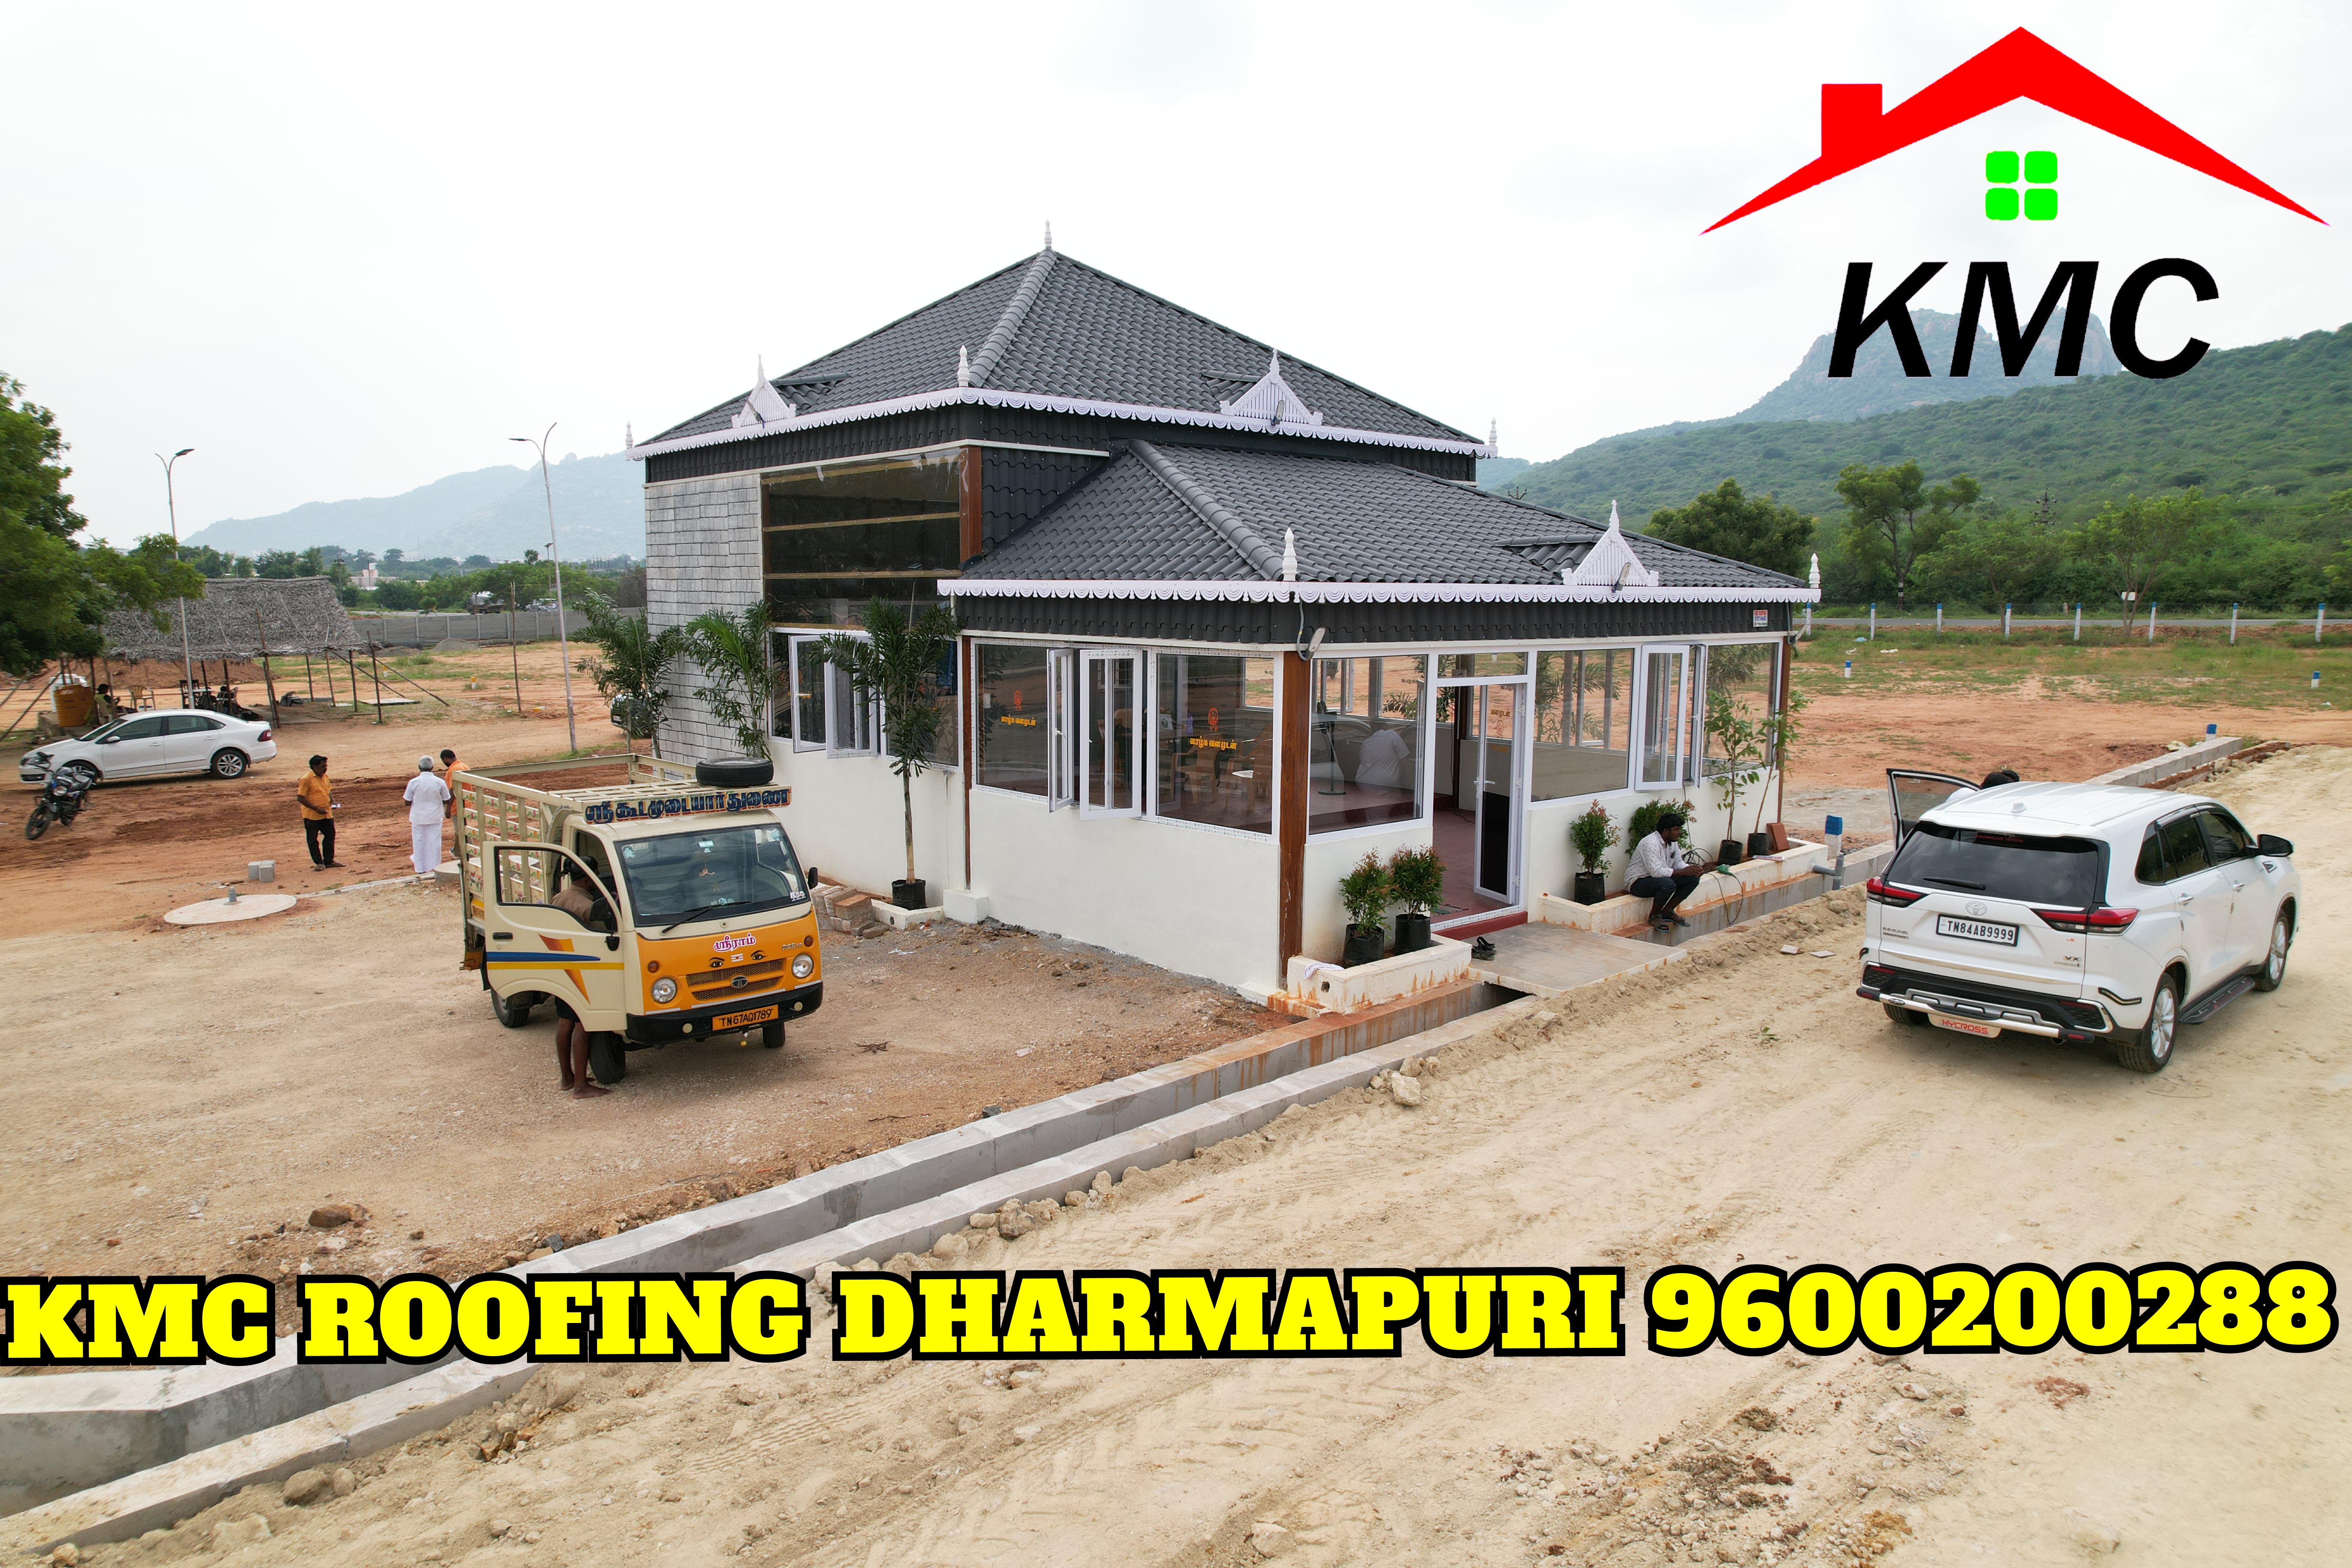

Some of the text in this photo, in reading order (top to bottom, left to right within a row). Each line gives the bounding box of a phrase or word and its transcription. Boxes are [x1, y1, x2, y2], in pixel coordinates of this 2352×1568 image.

[1001, 714, 1014, 725] வாழ்க
[1190, 735, 1237, 750] வாழ்க வளமுடன்
[1948, 920, 2014, 941] TN84AB9999
[1942, 1019, 1988, 1035] HYCROSS
